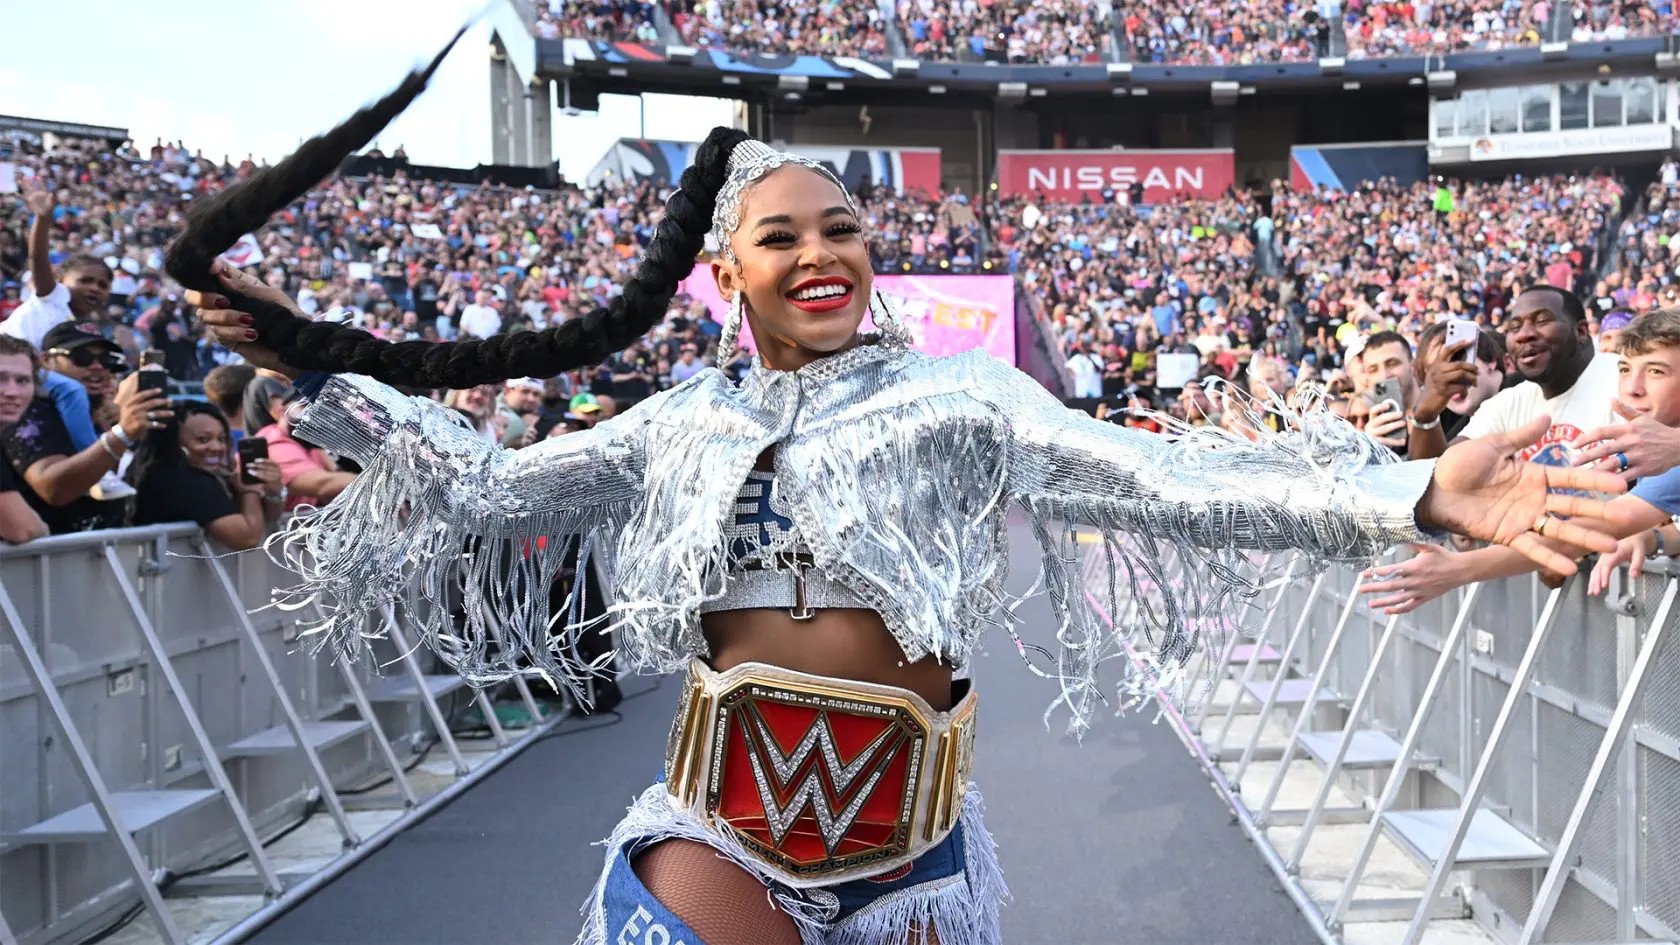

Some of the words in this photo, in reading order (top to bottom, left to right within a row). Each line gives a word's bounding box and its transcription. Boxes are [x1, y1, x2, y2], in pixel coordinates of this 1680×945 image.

[1028, 166, 1203, 190] NISSAN
[934, 303, 998, 334] EST
[735, 833, 794, 870] OMEN'S
[799, 849, 888, 874] CHAMPION
